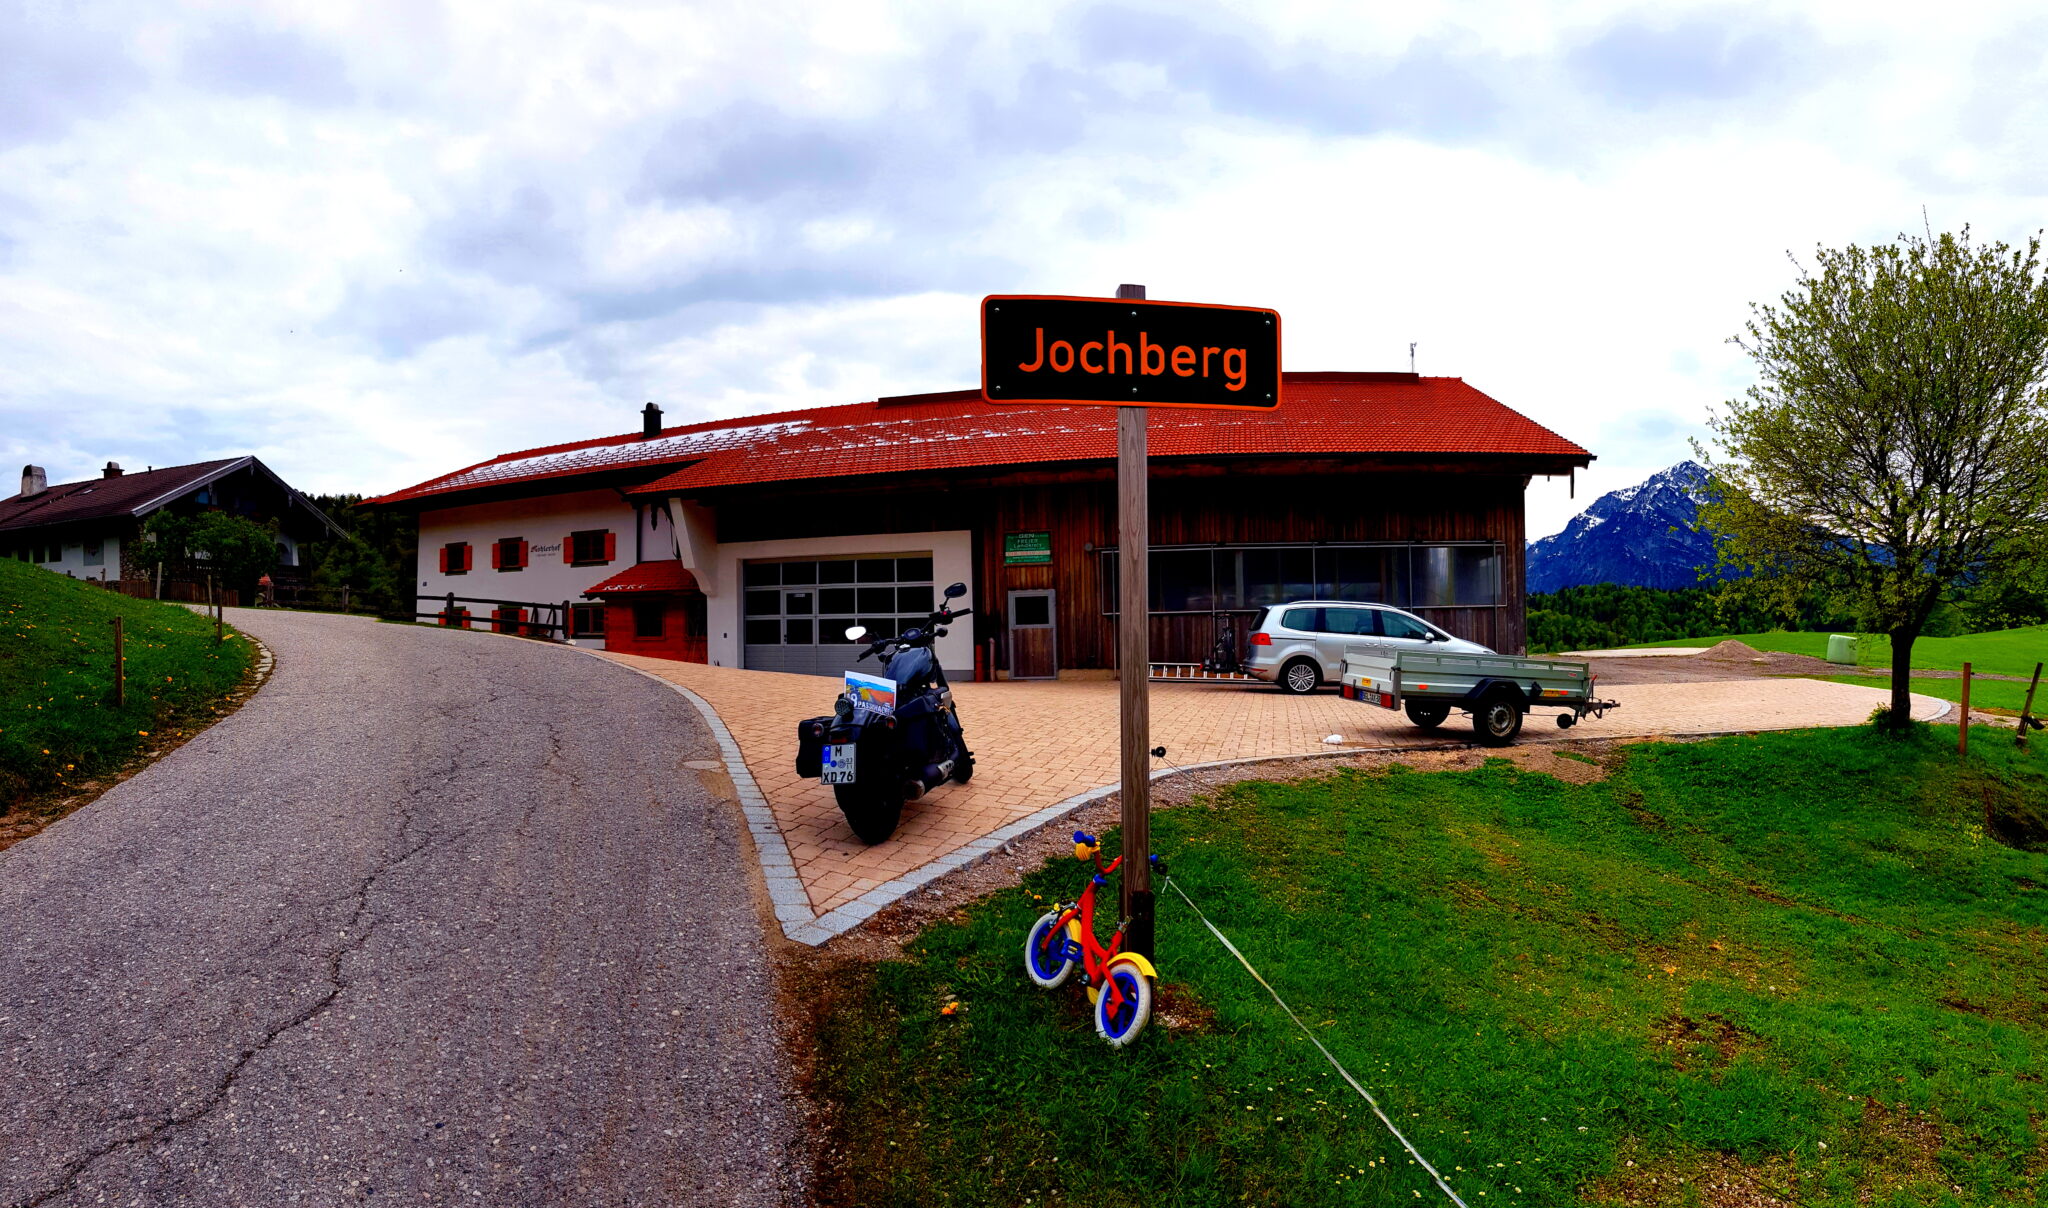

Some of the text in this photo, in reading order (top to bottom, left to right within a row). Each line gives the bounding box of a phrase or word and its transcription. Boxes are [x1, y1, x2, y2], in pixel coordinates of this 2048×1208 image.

[1018, 327, 1247, 392] Jochberg
[835, 746, 842, 757] M
[823, 771, 854, 783] XD 76
